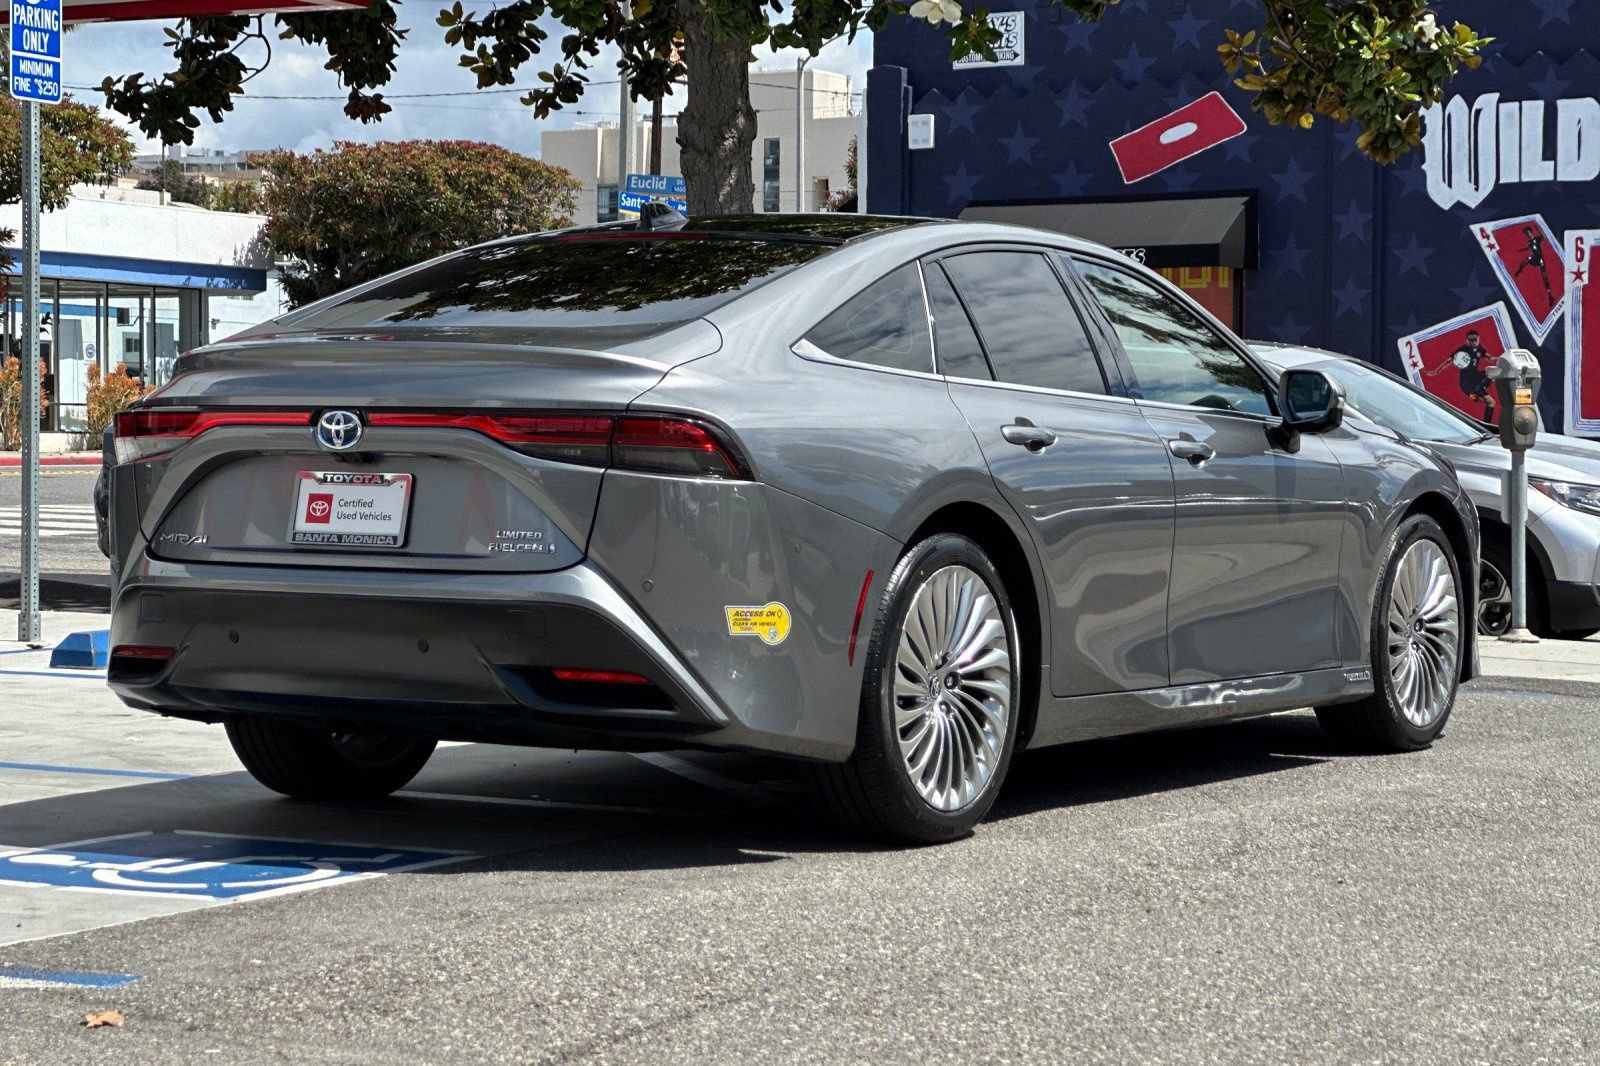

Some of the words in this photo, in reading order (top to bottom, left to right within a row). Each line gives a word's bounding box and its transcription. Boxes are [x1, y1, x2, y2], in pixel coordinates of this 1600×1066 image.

[13, 3, 59, 32] PARKING
[22, 29, 50, 53] ONLY
[19, 59, 53, 78] MINIMUM
[14, 76, 31, 93] FINE
[37, 79, 58, 97] $250
[1418, 92, 1600, 211] WILD
[630, 176, 667, 190] Euclid
[621, 193, 645, 208] Sant
[1479, 227, 1491, 241] 4
[1574, 236, 1586, 263] 6
[1405, 340, 1416, 360] 2
[324, 474, 382, 485] TOYOTA
[338, 498, 374, 508] Certified
[336, 511, 357, 521] Used
[359, 512, 392, 521] Vehicles
[295, 533, 338, 543] SANTA
[341, 534, 395, 545] MONICA
[496, 530, 543, 540] LIMITED
[765, 610, 777, 618] OK
